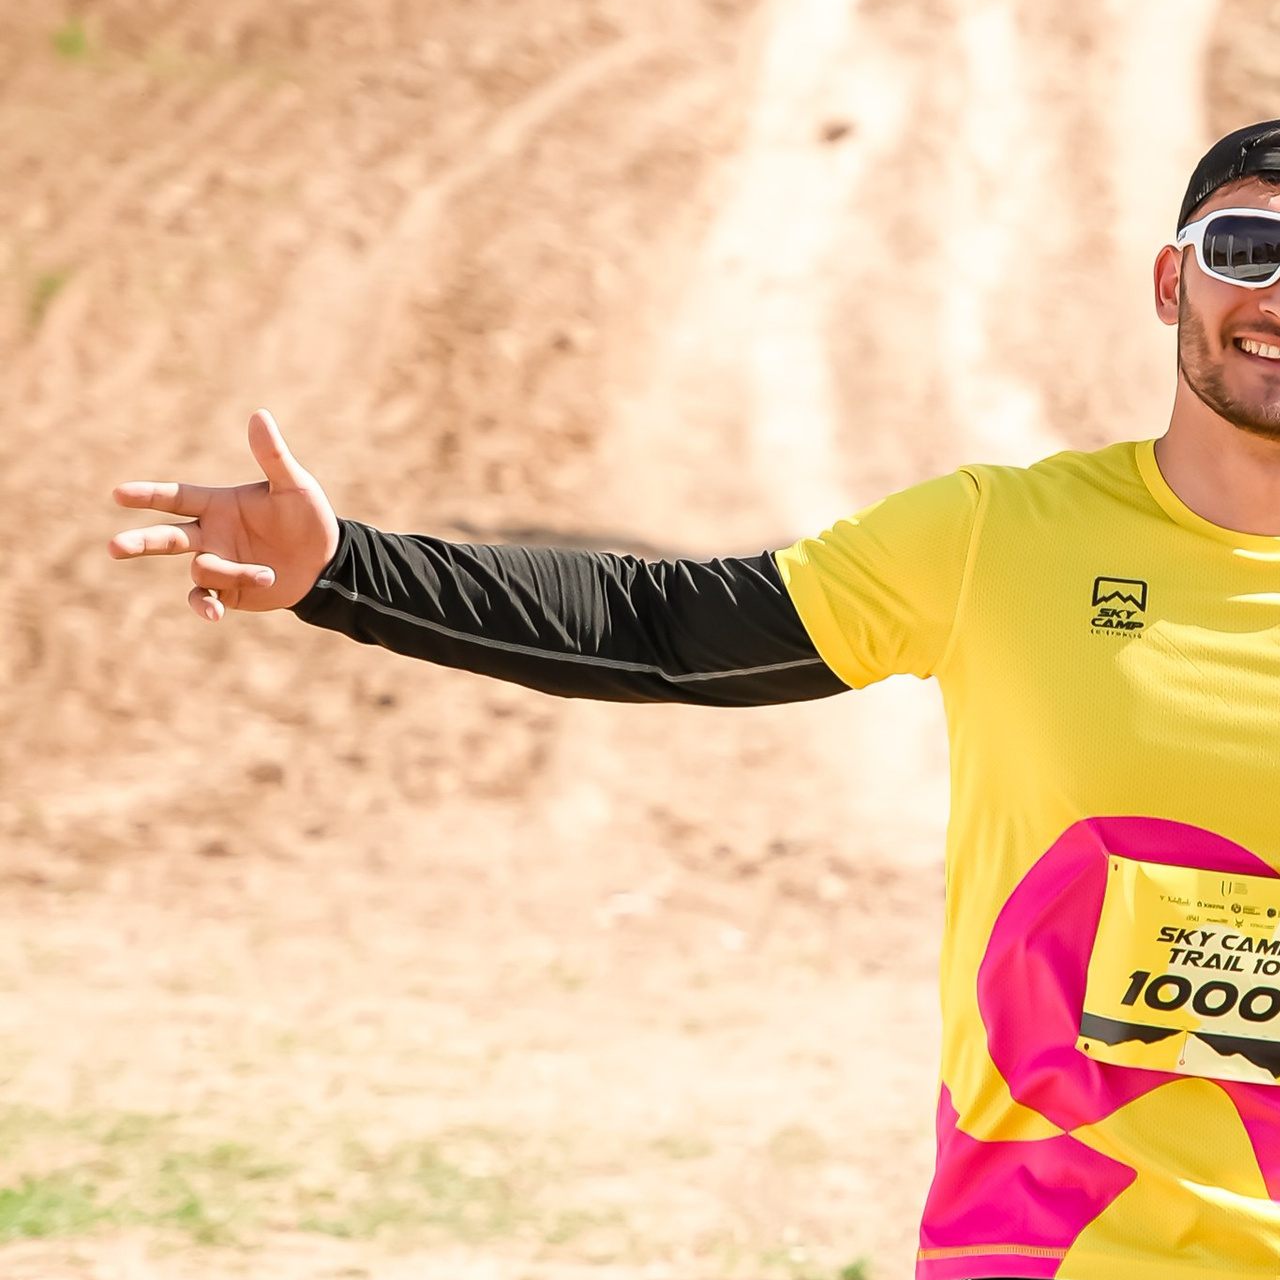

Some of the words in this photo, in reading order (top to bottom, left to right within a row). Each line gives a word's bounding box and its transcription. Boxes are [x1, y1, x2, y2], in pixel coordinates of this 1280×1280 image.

[1097, 607, 1138, 620] SKY
[1091, 618, 1145, 631] CAMP
[1156, 926, 1216, 948] SKY
[1168, 947, 1245, 973] TRAIL
